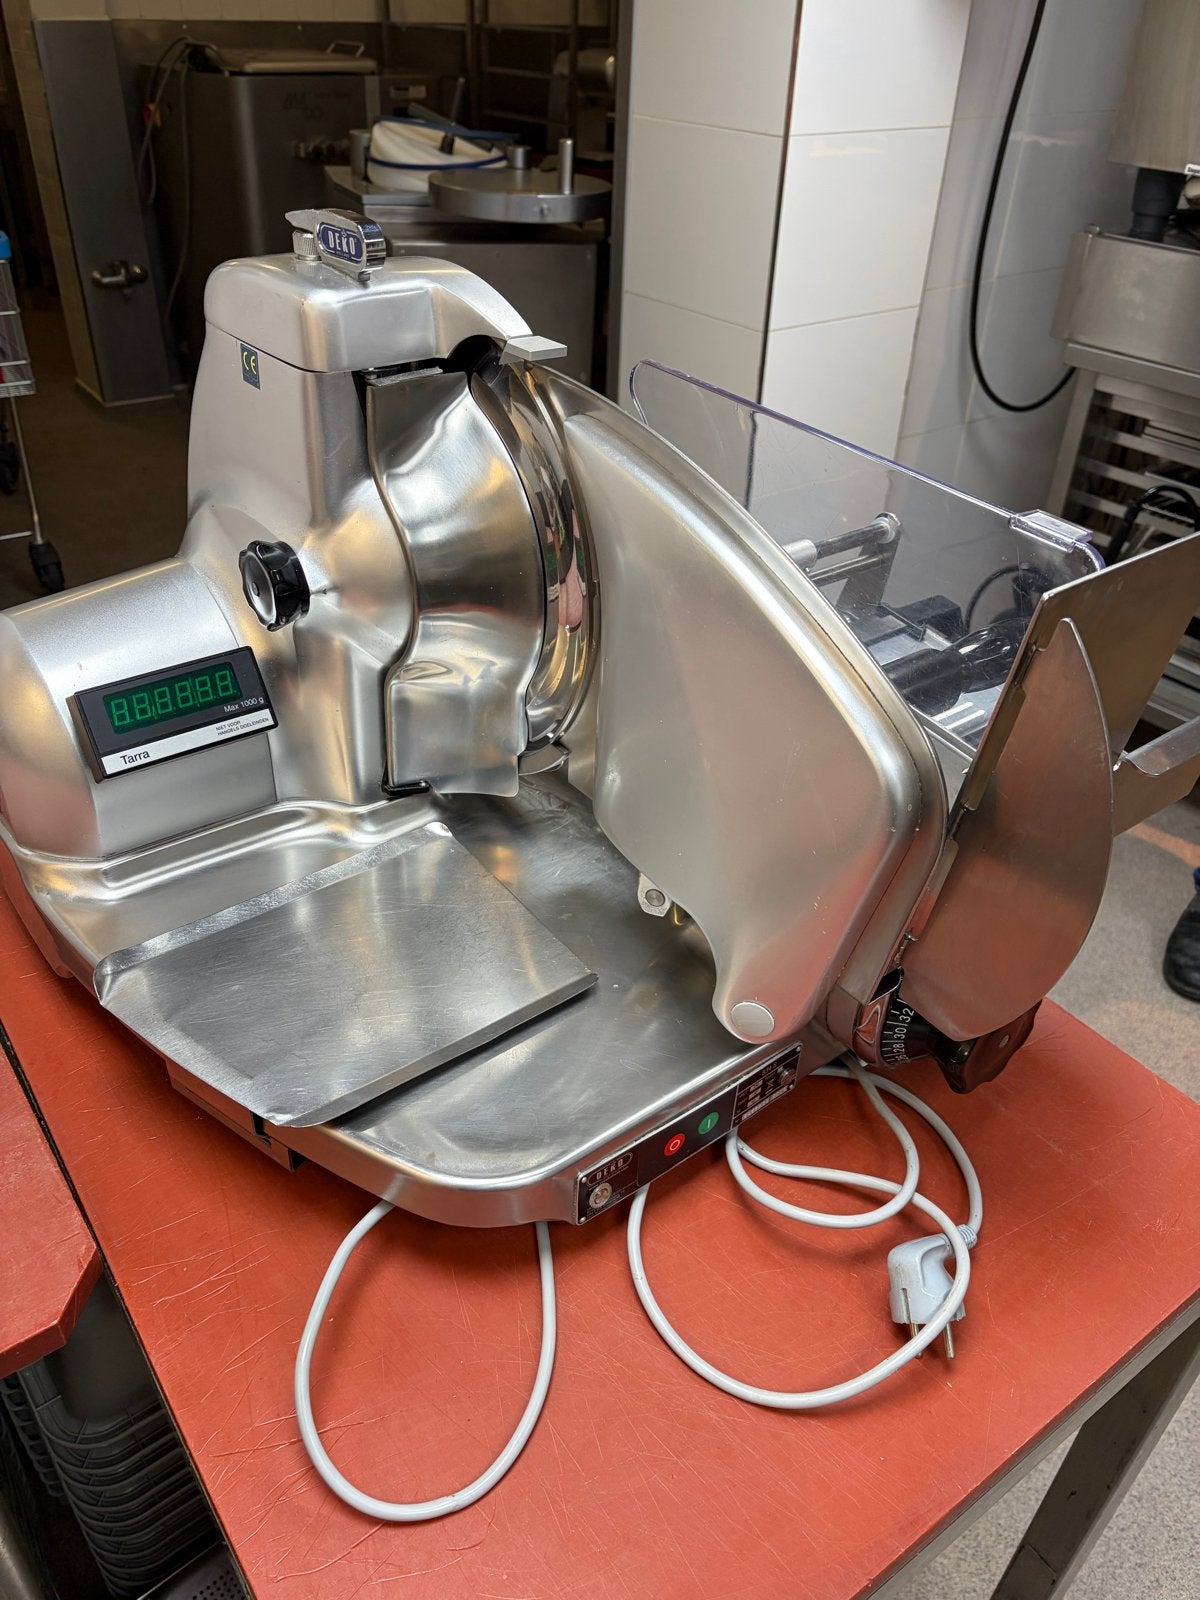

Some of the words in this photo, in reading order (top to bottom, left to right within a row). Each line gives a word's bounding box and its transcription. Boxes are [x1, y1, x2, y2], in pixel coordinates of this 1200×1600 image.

[327, 230, 356, 255] DEKO
[223, 704, 240, 713] Max
[240, 697, 258, 708] 1000
[258, 696, 265, 704] g
[215, 723, 227, 731] NIET
[227, 719, 242, 728] VOOR
[217, 726, 240, 736] HANDELS
[240, 717, 270, 730] DOELEINDEN
[120, 750, 150, 765] Tarra
[899, 1007, 915, 1023] 32
[893, 1027, 907, 1040] 30
[892, 1043, 905, 1053] 28
[596, 1158, 624, 1180] DEKO
